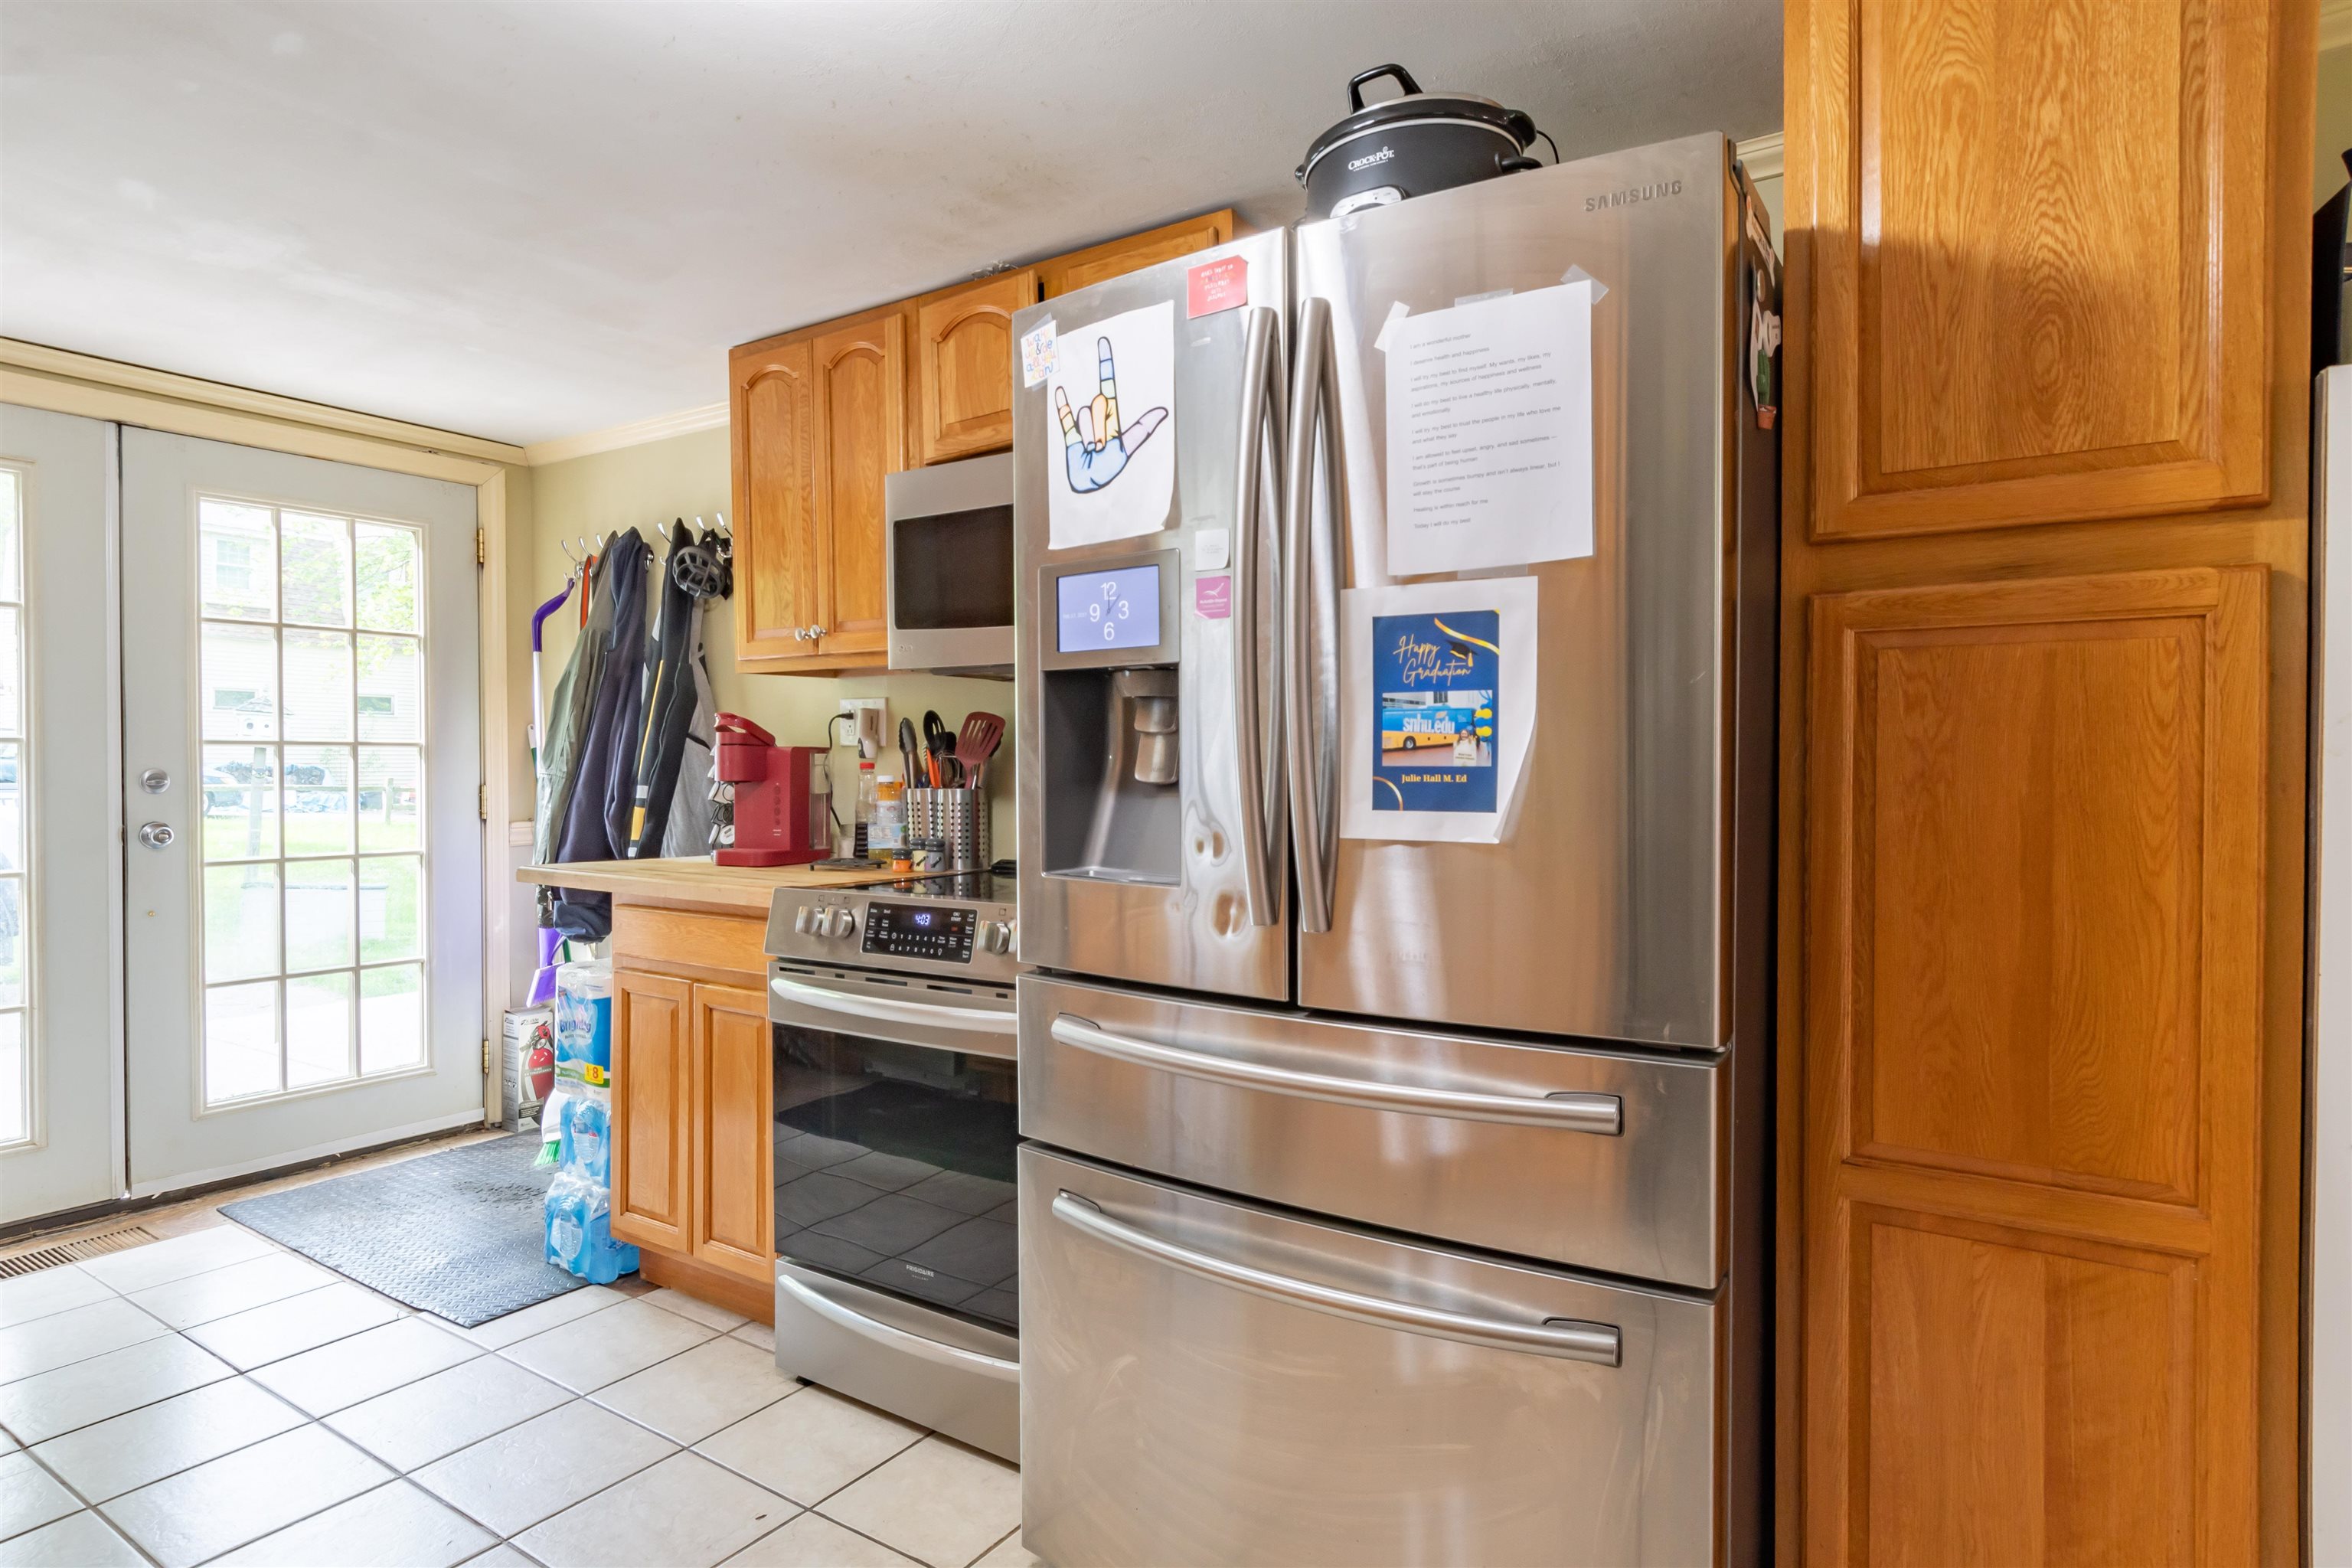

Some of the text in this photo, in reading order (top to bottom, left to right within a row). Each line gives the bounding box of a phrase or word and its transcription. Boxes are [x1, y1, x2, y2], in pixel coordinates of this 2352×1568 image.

[1584, 180, 1682, 212] SAMSUNG
[1100, 581, 1117, 601] 12
[1089, 600, 1129, 622] 9 3
[1104, 622, 1115, 641] 6
[1393, 634, 1440, 668] Happy
[1403, 658, 1471, 687] Graduation
[1403, 713, 1455, 733] snhu.edu
[1401, 774, 1468, 784] Julie Hall M. Ed
[916, 913, 930, 926] 4:03
[593, 1067, 599, 1080] 8
[906, 1264, 934, 1278] FRIGIDAIRE
